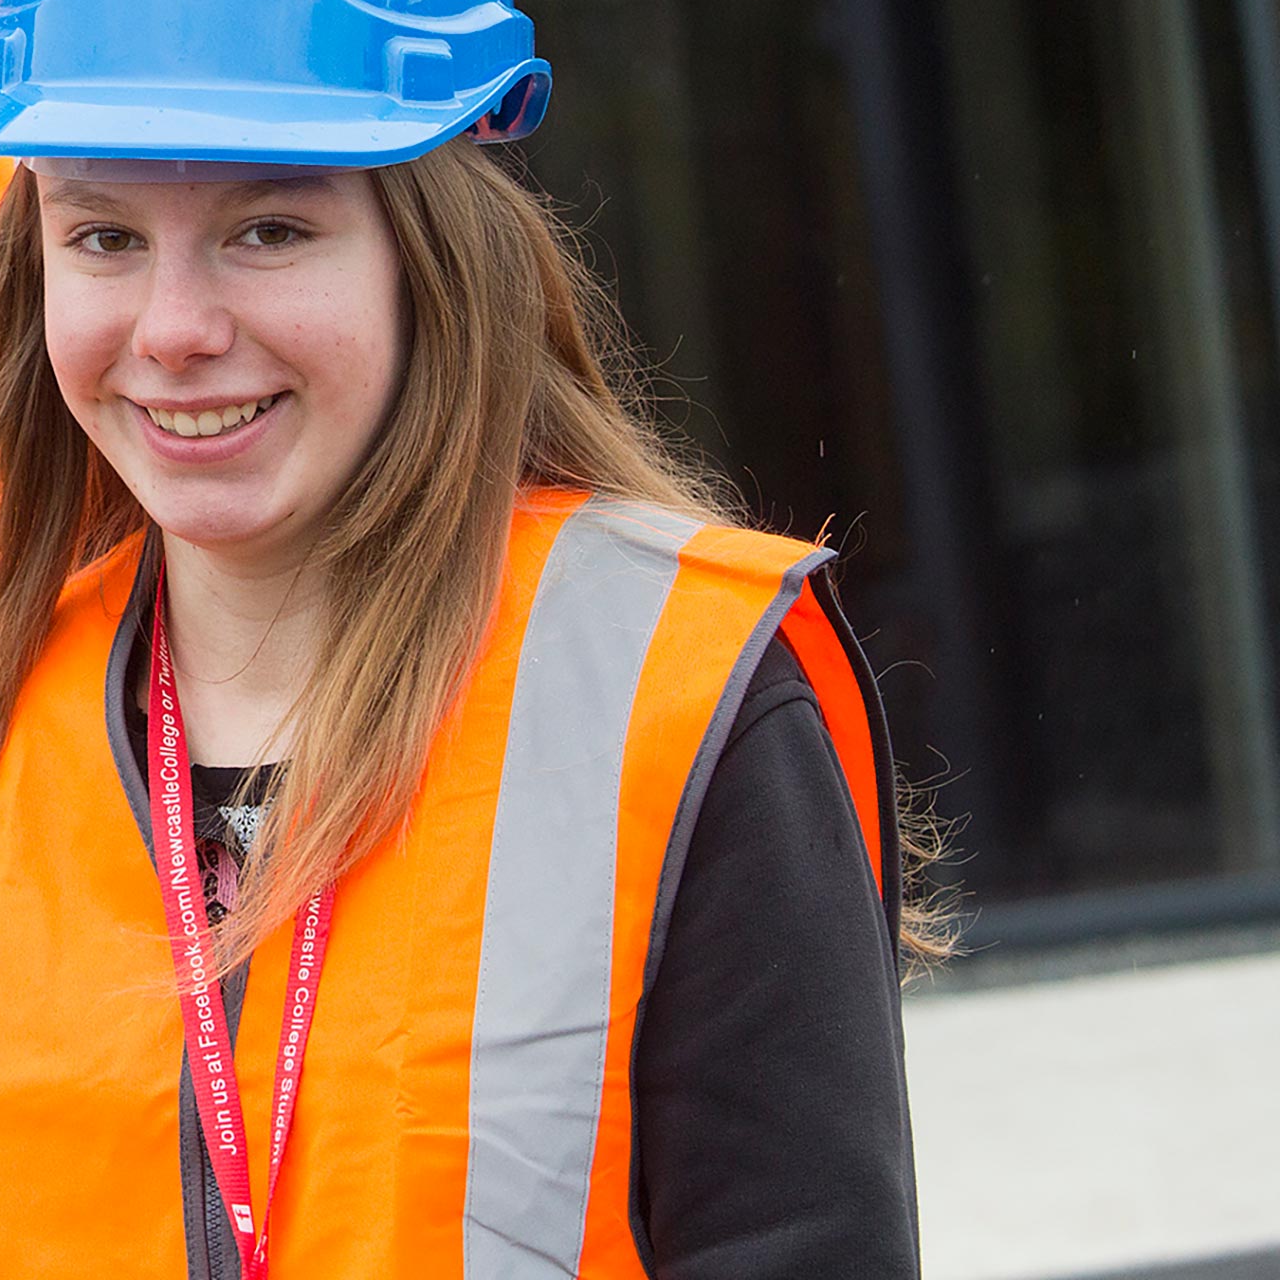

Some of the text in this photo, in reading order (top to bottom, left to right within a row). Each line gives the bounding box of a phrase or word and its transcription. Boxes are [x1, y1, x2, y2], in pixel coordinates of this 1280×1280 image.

[162, 689, 174, 711] or
[297, 888, 322, 981] wcastle
[283, 987, 310, 1072] College
[202, 1051, 223, 1073] at
[211, 1078, 228, 1106] us
[215, 1109, 237, 1156] Join
